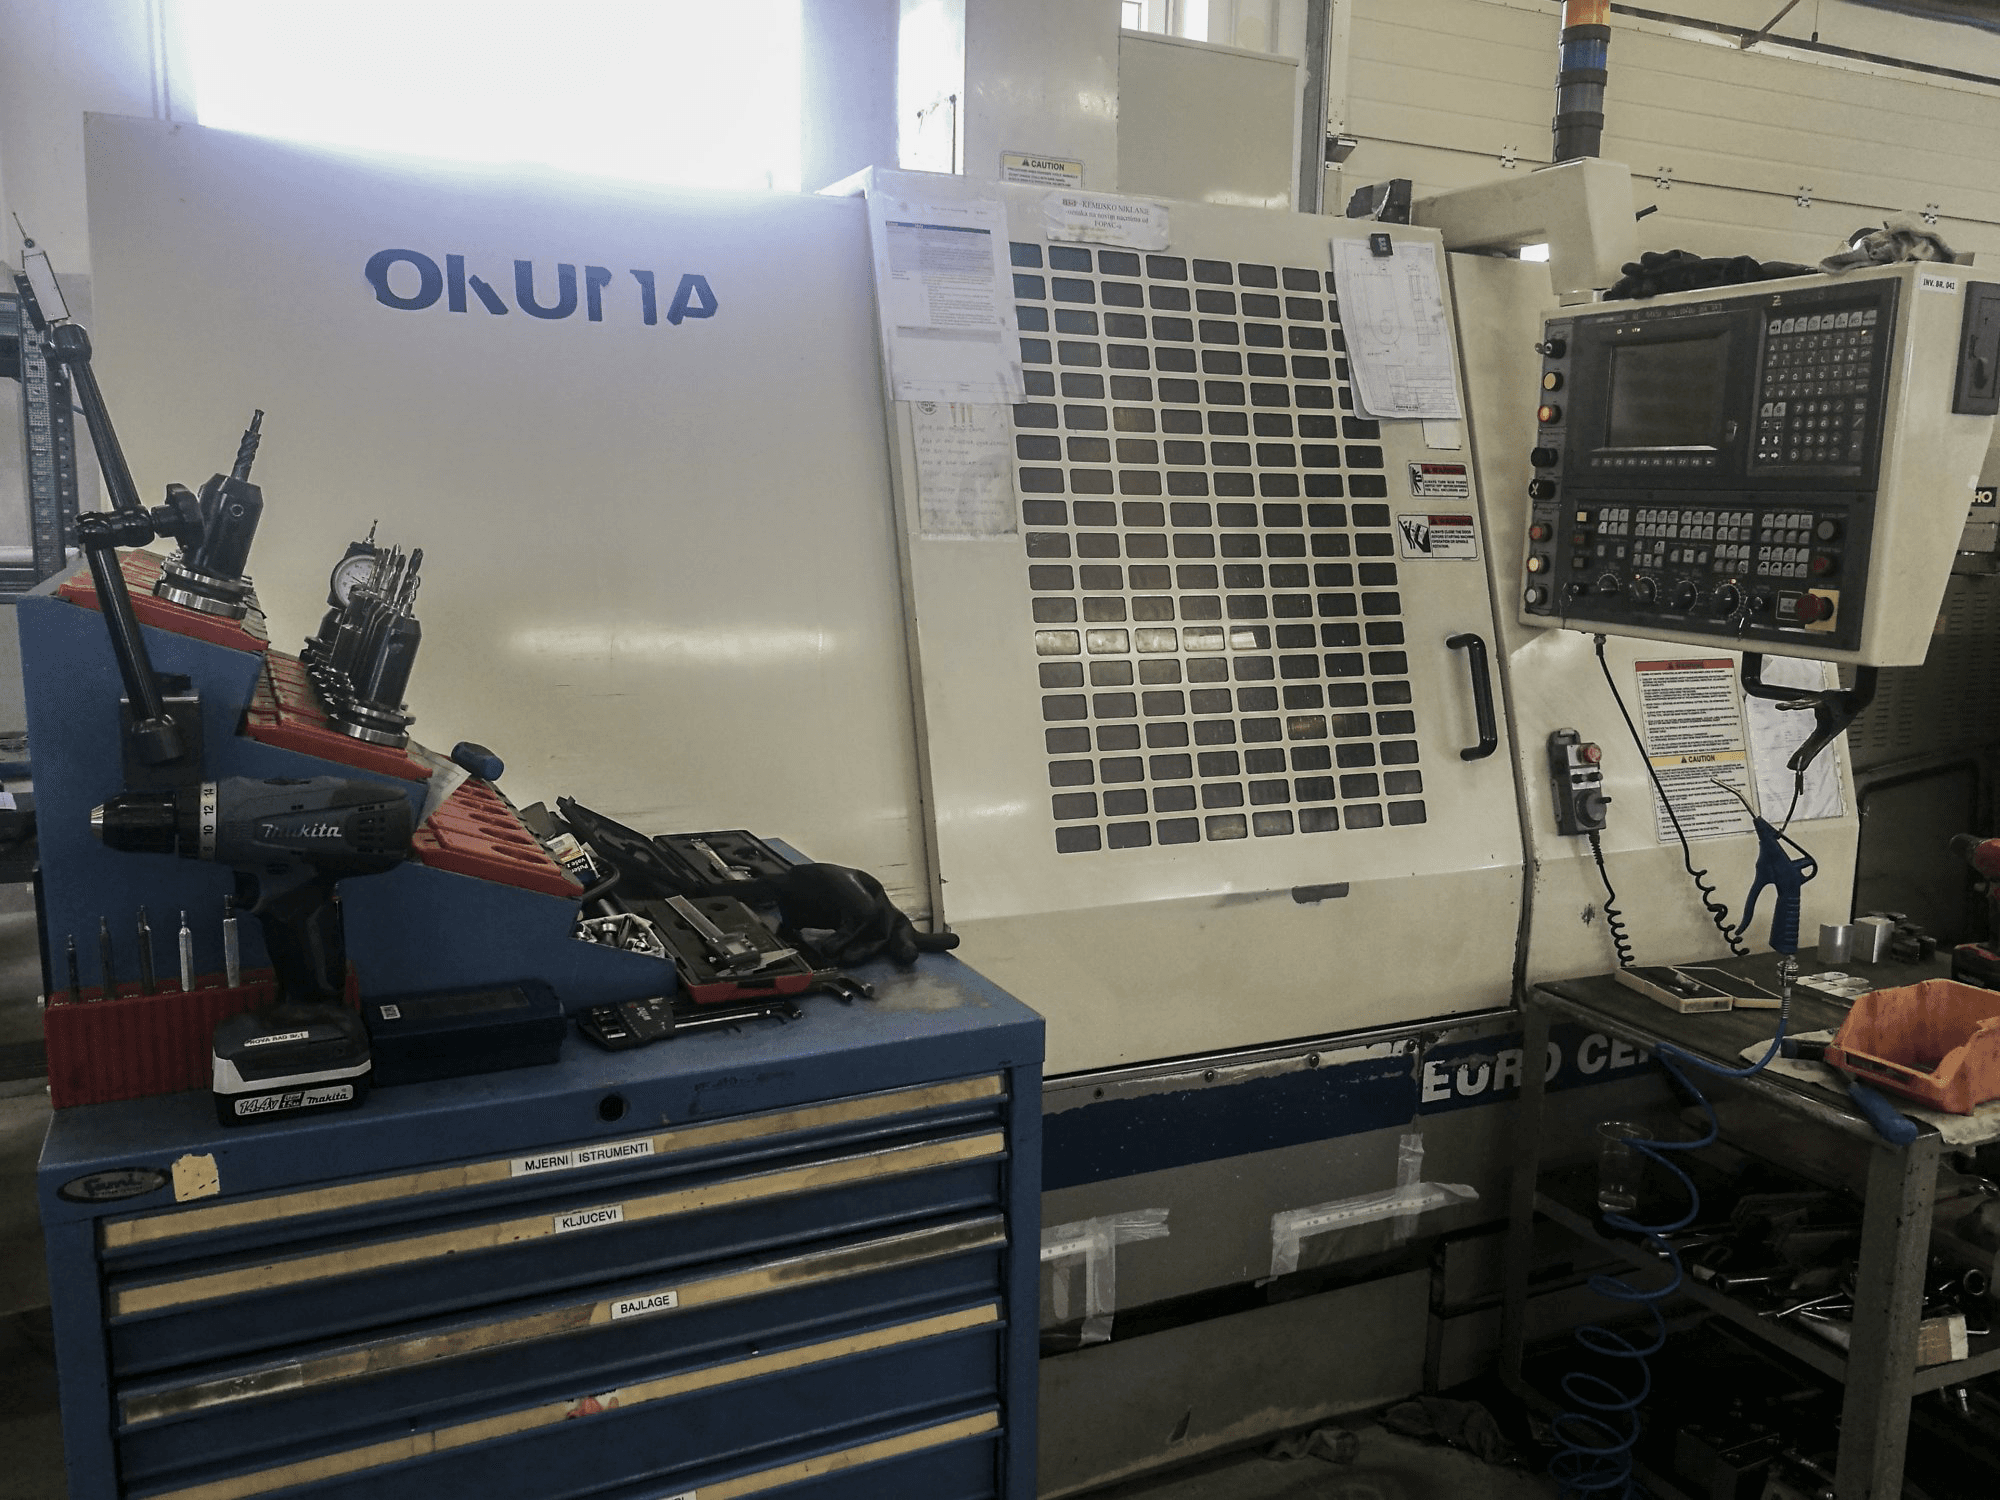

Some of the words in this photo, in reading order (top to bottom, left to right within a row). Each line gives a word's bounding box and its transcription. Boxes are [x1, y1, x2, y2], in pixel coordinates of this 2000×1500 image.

[1031, 160, 1065, 171] CAUTION
[1923, 278, 1934, 287] INV.
[1936, 280, 1945, 288] BR.
[1945, 281, 1955, 290] 041
[1688, 754, 1716, 763] CAUTION
[203, 787, 214, 798] 14
[203, 804, 214, 816] 12
[203, 824, 214, 836] 10
[307, 1091, 349, 1105] makita
[525, 1155, 569, 1171] MJERNI
[578, 1142, 648, 1163] ISTRUMENTI
[563, 1209, 617, 1229] KLJUCEVI
[620, 1295, 670, 1314] BAJLAGE
